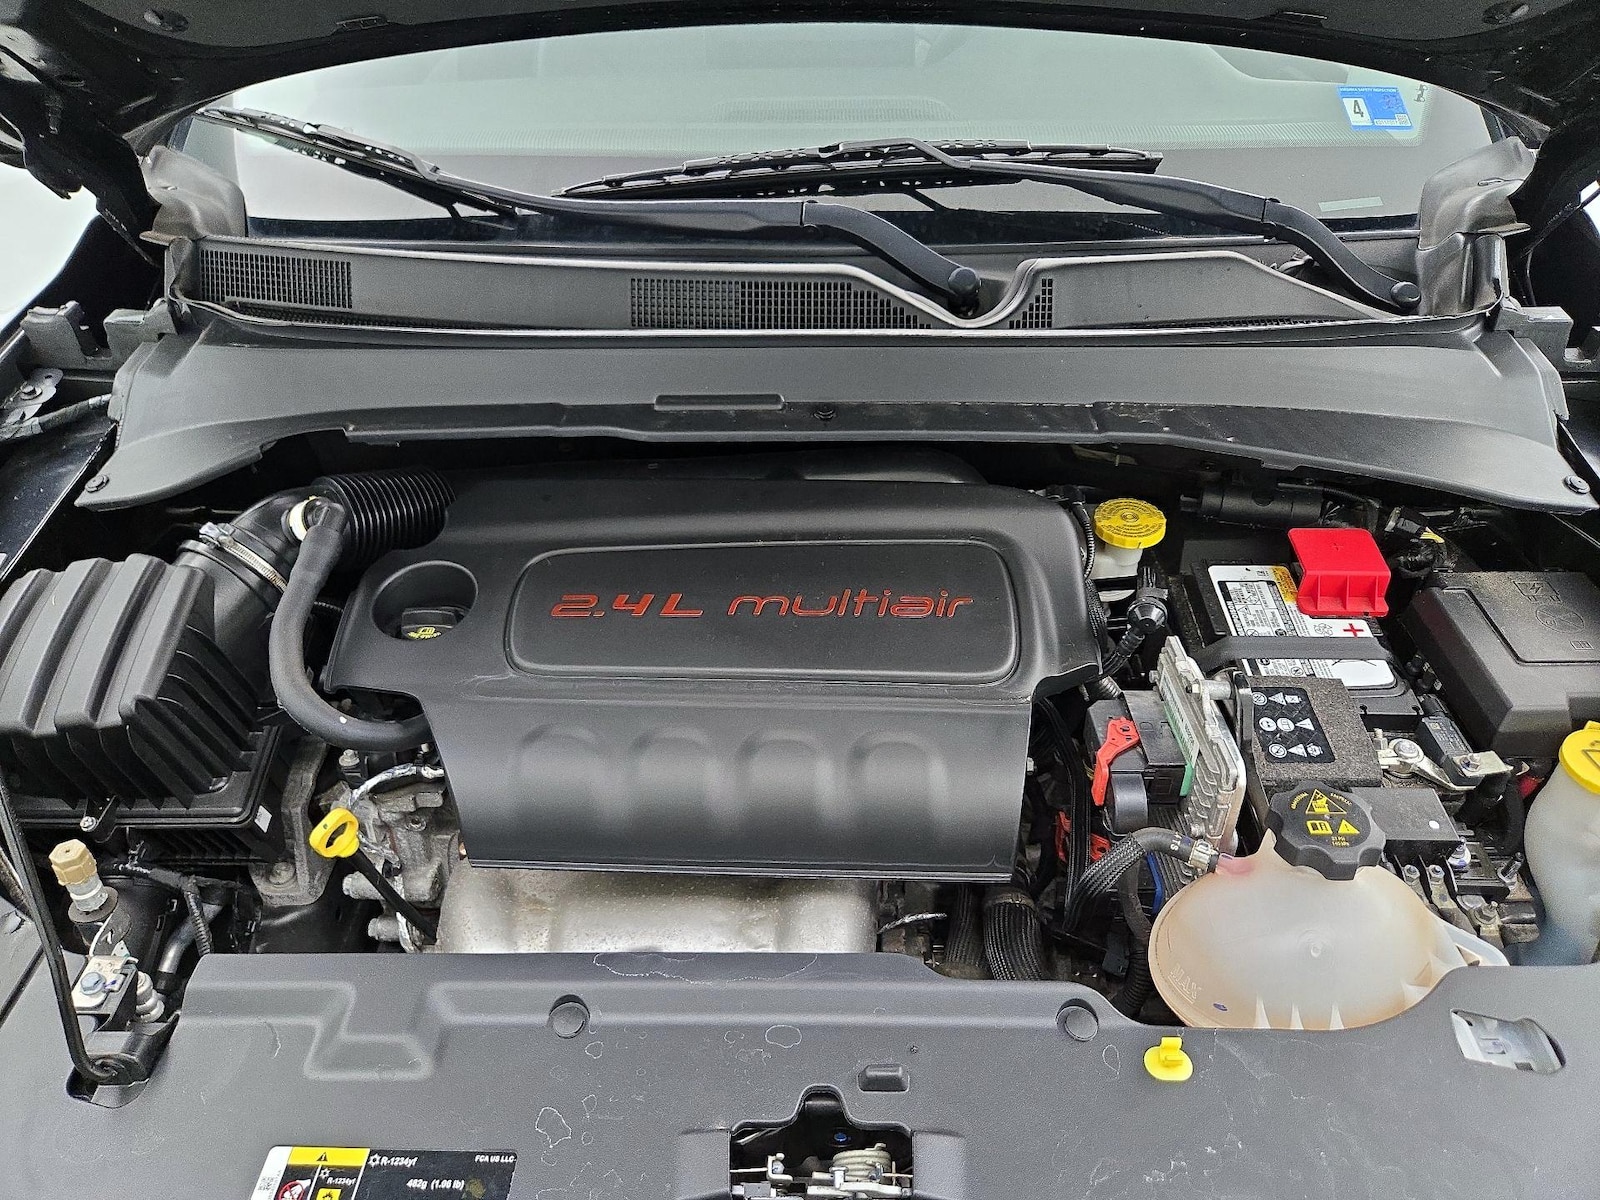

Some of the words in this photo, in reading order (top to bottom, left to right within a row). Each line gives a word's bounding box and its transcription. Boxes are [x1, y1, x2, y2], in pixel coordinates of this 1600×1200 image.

[1353, 99, 1364, 118] 4
[728, 588, 974, 618] multiair
[475, 1154, 489, 1163] FCA
[490, 1154, 499, 1163] US
